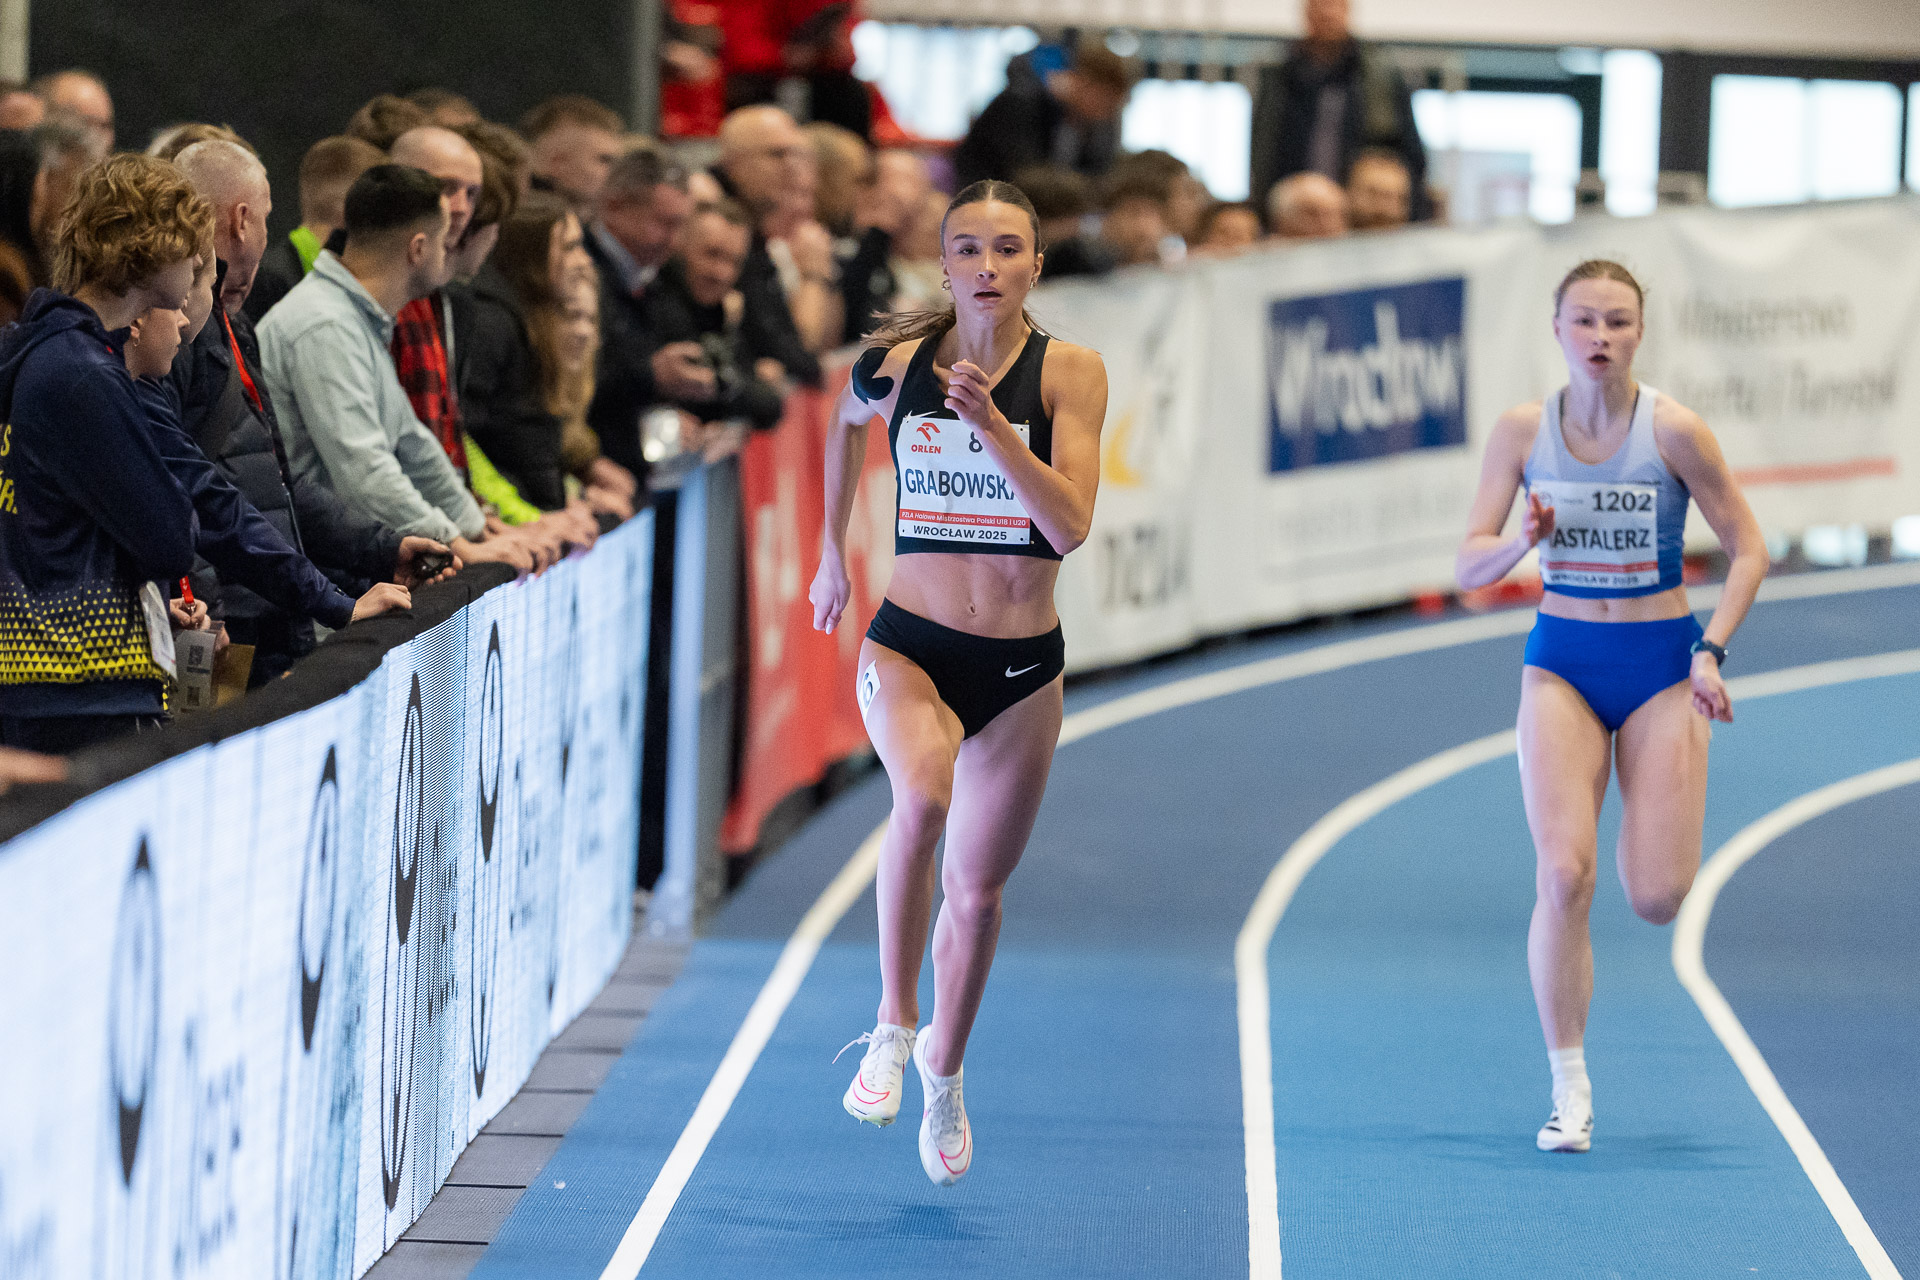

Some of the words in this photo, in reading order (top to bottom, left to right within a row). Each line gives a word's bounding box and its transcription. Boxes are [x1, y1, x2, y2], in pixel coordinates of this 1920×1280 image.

[911, 444, 942, 454] ORLEN
[1592, 490, 1652, 512] 1202
[901, 511, 914, 519] PZLA
[915, 513, 936, 521] Halowe
[936, 514, 976, 523] Mistrzostwa
[976, 517, 996, 525] Polski
[996, 518, 1008, 526] U18
[913, 525, 975, 539] WROCŁAW
[977, 530, 1007, 541] 2025
[1552, 528, 1651, 551] ASTALERZ
